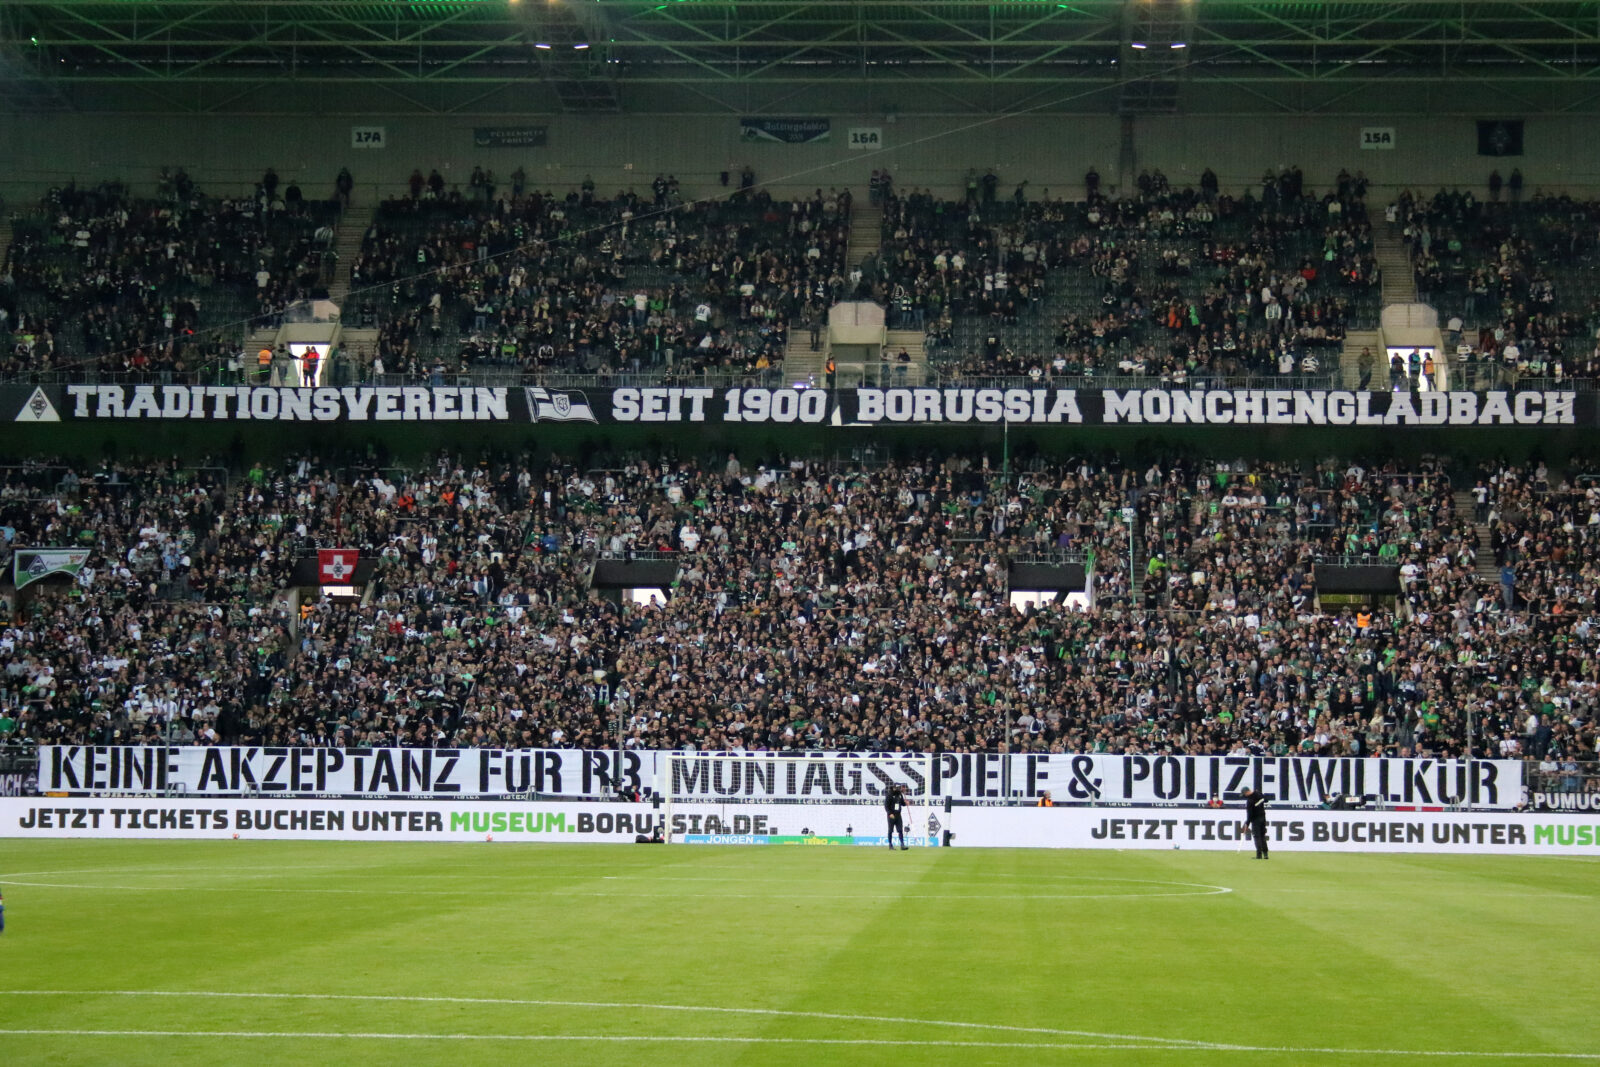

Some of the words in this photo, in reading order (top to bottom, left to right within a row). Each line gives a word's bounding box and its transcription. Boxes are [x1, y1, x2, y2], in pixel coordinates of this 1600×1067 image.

[355, 131, 382, 143] 17A
[851, 132, 878, 144] 16A
[1364, 132, 1391, 144] 15A
[67, 385, 509, 421] TRADITIONSVEREIN
[612, 388, 714, 422] SEIT
[723, 388, 827, 423] 1900
[856, 389, 1083, 423] BORUSSIA
[51, 746, 179, 791] KEINE
[197, 747, 462, 793] AKZEPTANZ
[479, 748, 563, 793] FÜR
[671, 752, 1050, 798] MONTAGSSPIELE
[1067, 755, 1103, 799] &
[1123, 756, 1499, 806] POLIZEIWILLKÜR
[19, 808, 105, 829] JETZT
[110, 809, 229, 830] TICKETS
[235, 810, 345, 831] BUCHEN
[353, 811, 443, 832] UNTER
[1091, 819, 1178, 840] JETZT
[1312, 821, 1424, 843] BUCHEN
[1432, 823, 1527, 845] UNTER
